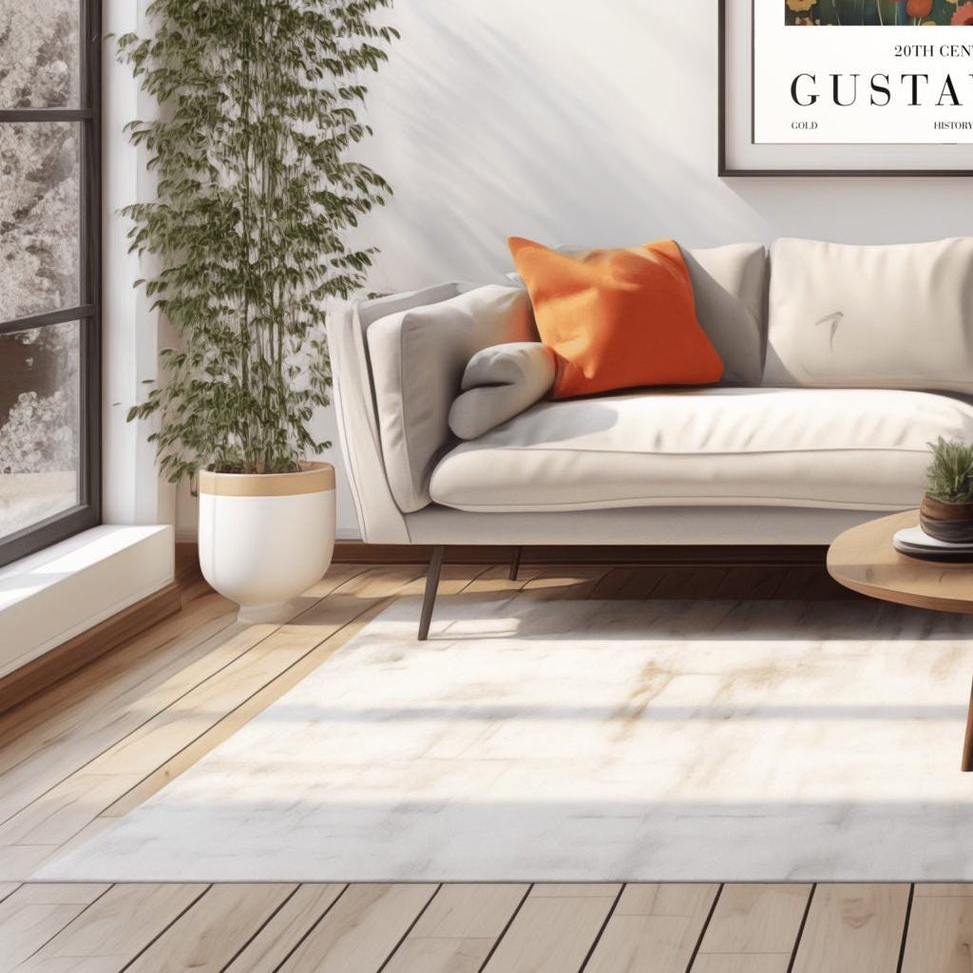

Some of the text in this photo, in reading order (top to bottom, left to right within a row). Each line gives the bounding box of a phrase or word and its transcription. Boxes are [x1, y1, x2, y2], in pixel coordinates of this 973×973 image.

[893, 44, 935, 58] 20TH
[790, 121, 818, 130] GOLD
[933, 121, 973, 130] HISTORY
